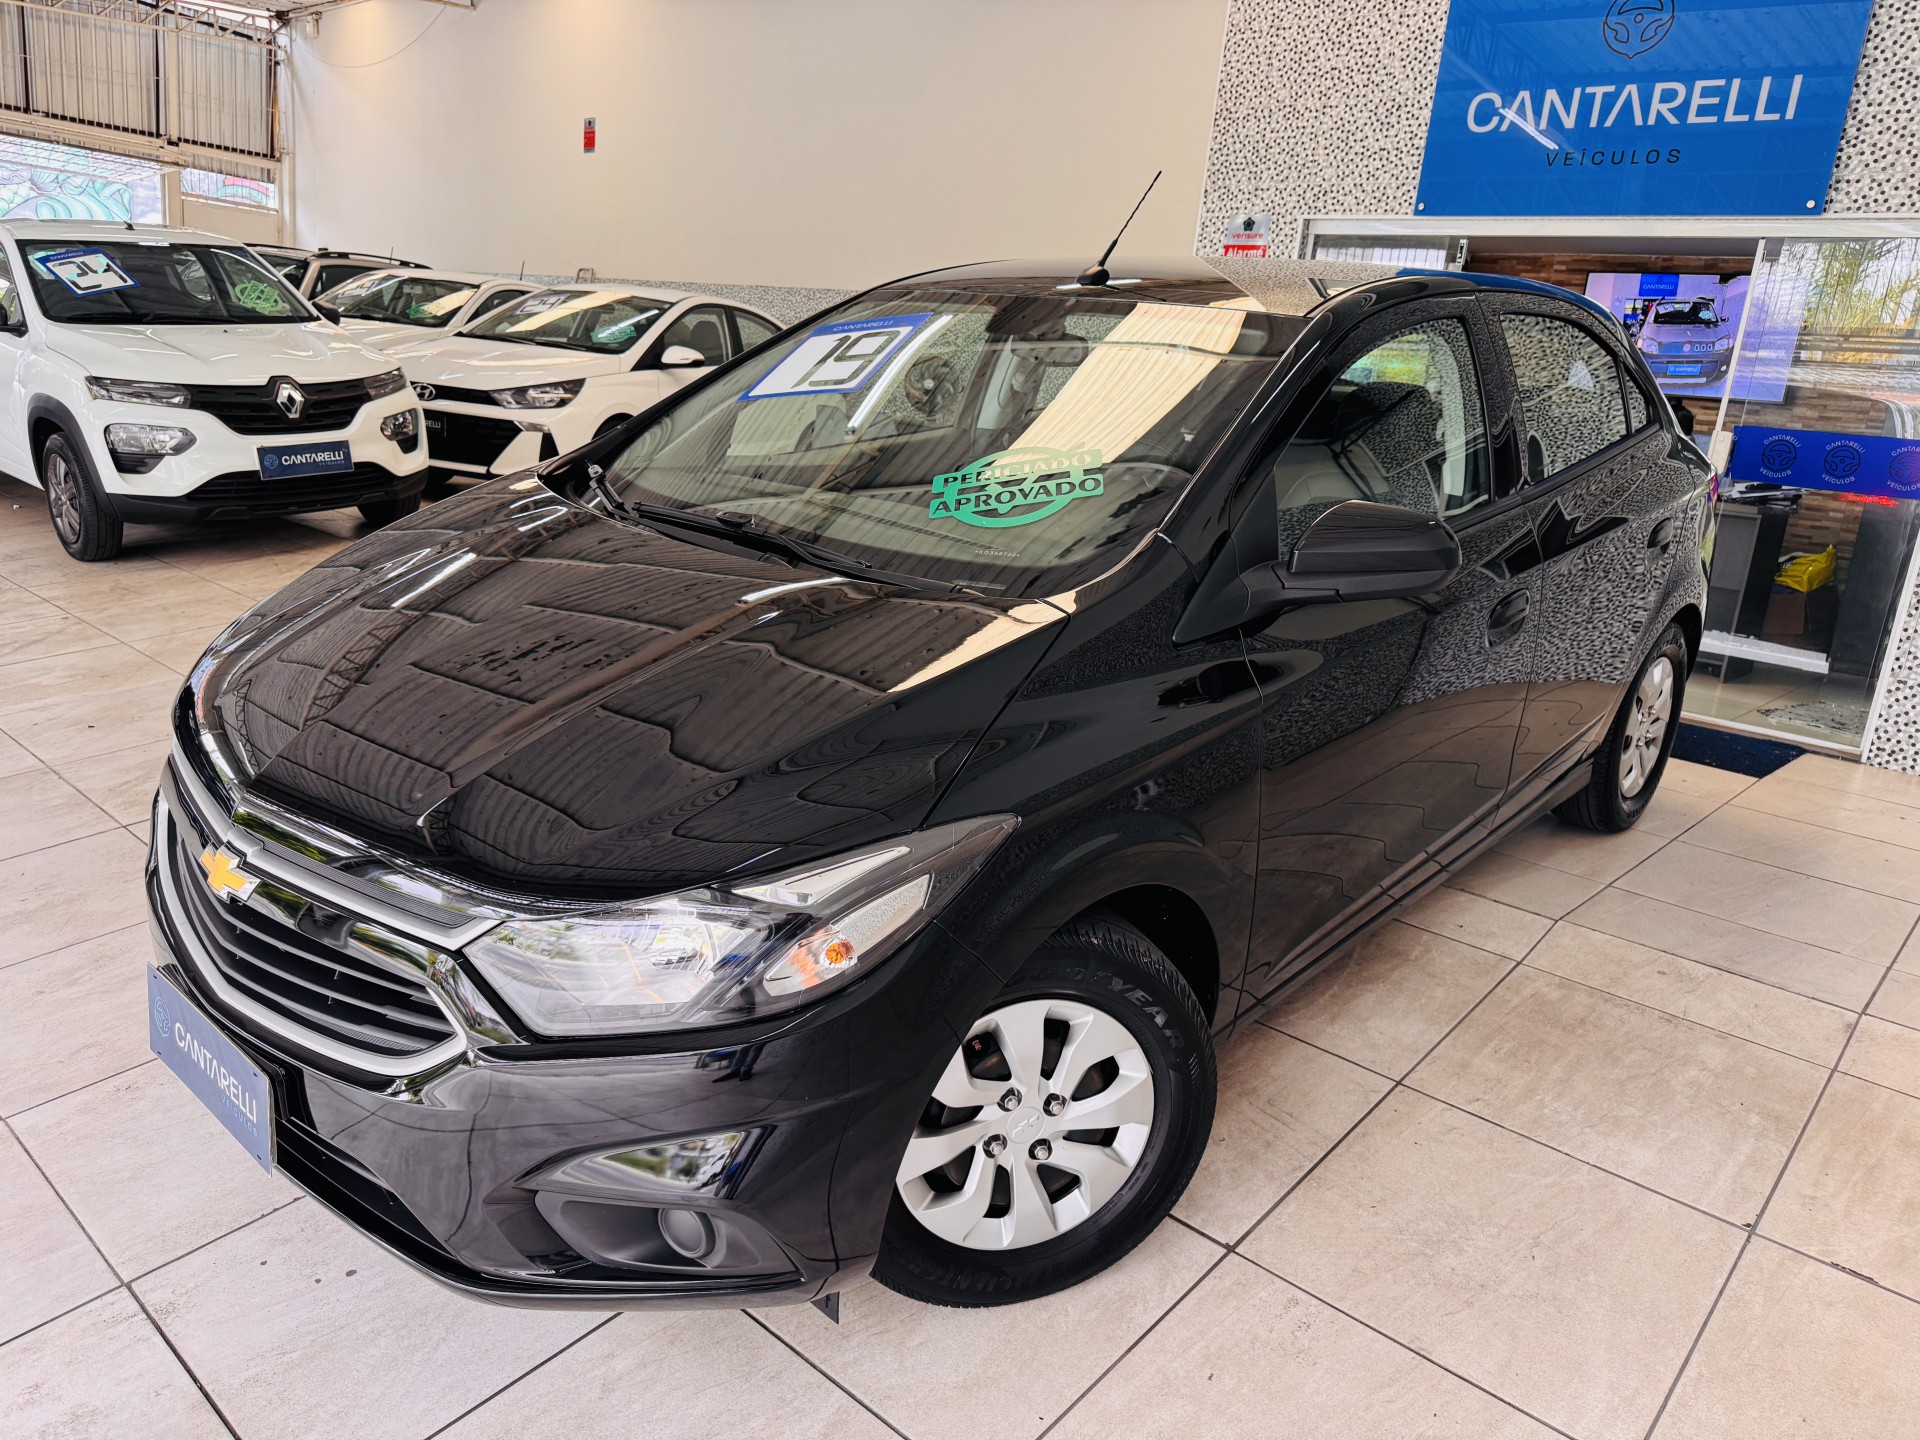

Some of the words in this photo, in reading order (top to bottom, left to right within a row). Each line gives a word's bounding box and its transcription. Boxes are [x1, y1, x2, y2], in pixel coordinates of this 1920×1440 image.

[1466, 75, 1803, 133] CANTARELLI
[1546, 148, 1682, 167] VEÍCULOS
[52, 255, 128, 292] 24
[520, 297, 562, 313] 24
[833, 320, 894, 332] CANTARELLI
[791, 330, 901, 389] 19
[425, 420, 441, 428] RELLI
[1764, 434, 1802, 448] CANTARELLI
[1826, 440, 1866, 454] CANTARELLI
[281, 450, 344, 465] CANTARELLI
[1891, 446, 1920, 457] CANTAR
[943, 453, 1092, 488] PERICIADO
[932, 478, 1102, 515] APROVADO
[175, 1022, 257, 1124] CANTARELLI
